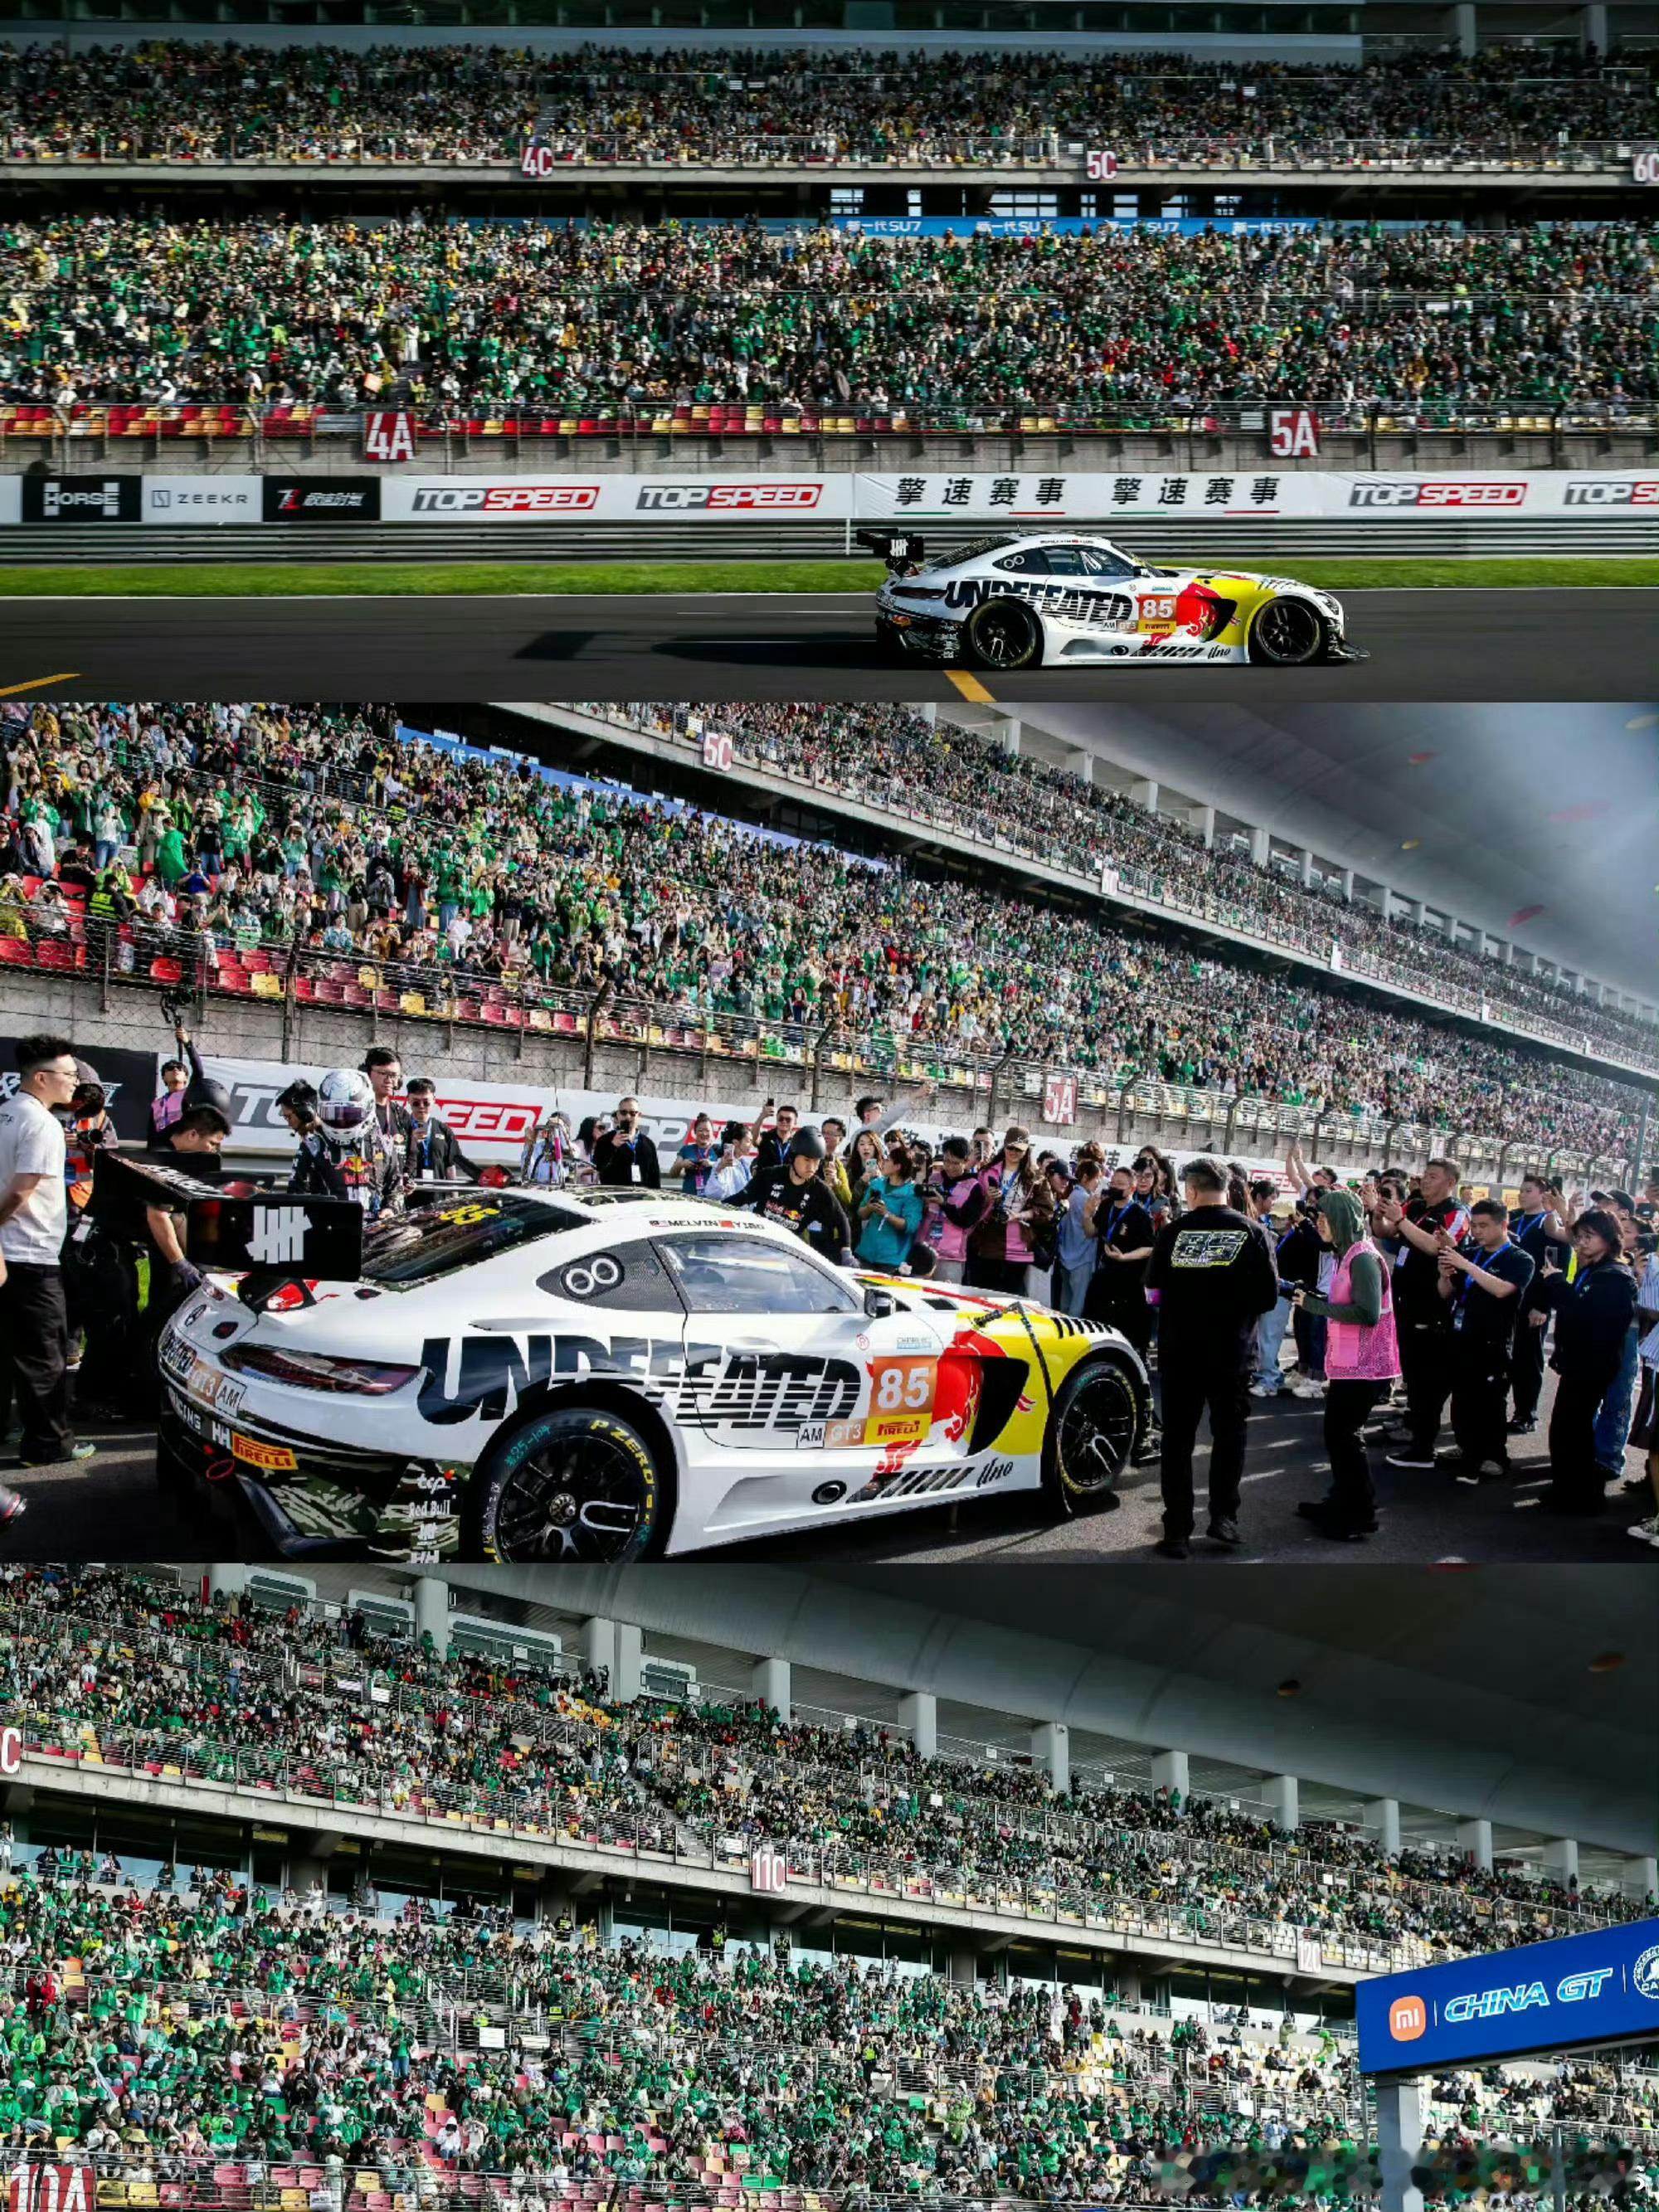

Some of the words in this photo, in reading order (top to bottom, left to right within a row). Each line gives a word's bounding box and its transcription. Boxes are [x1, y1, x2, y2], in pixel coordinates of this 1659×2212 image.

[522, 146, 553, 176] 4C
[1087, 150, 1117, 179] 5C
[367, 412, 416, 460] 4A
[1271, 411, 1318, 457] 5A
[177, 493, 248, 505] ZEEKR
[418, 488, 484, 510] TOP
[485, 487, 597, 508] SPEED
[640, 487, 708, 508] TOP
[708, 485, 820, 507] SPEED
[895, 477, 1066, 506] 擎速赛事
[1111, 477, 1280, 505] 擎速赛事
[1354, 484, 1419, 505] TOP
[1418, 484, 1527, 505] SPEED
[1569, 484, 1632, 505] TOP
[1632, 484, 1659, 504] S
[945, 580, 1133, 623] UNDEFEATED
[1142, 599, 1174, 619] 85
[703, 732, 733, 771] 5C
[217, 1385, 240, 1408] AM
[416, 1334, 862, 1433] UNDEFEATED
[878, 1367, 930, 1409] 85
[800, 1427, 823, 1442] AM
[830, 1424, 862, 1441] GT3
[877, 1420, 920, 1437] PIRELLI
[235, 1437, 293, 1467] PIRELLI
[590, 1419, 610, 1431] P
[611, 1426, 655, 1485] ZERO
[409, 1500, 428, 1518] Red
[431, 1500, 450, 1516] Bull
[752, 1849, 786, 1892] 11C
[1444, 1981, 1550, 2023] CHINA
[1556, 1966, 1613, 2003] GT
[11, 2163, 87, 2212] 10A
